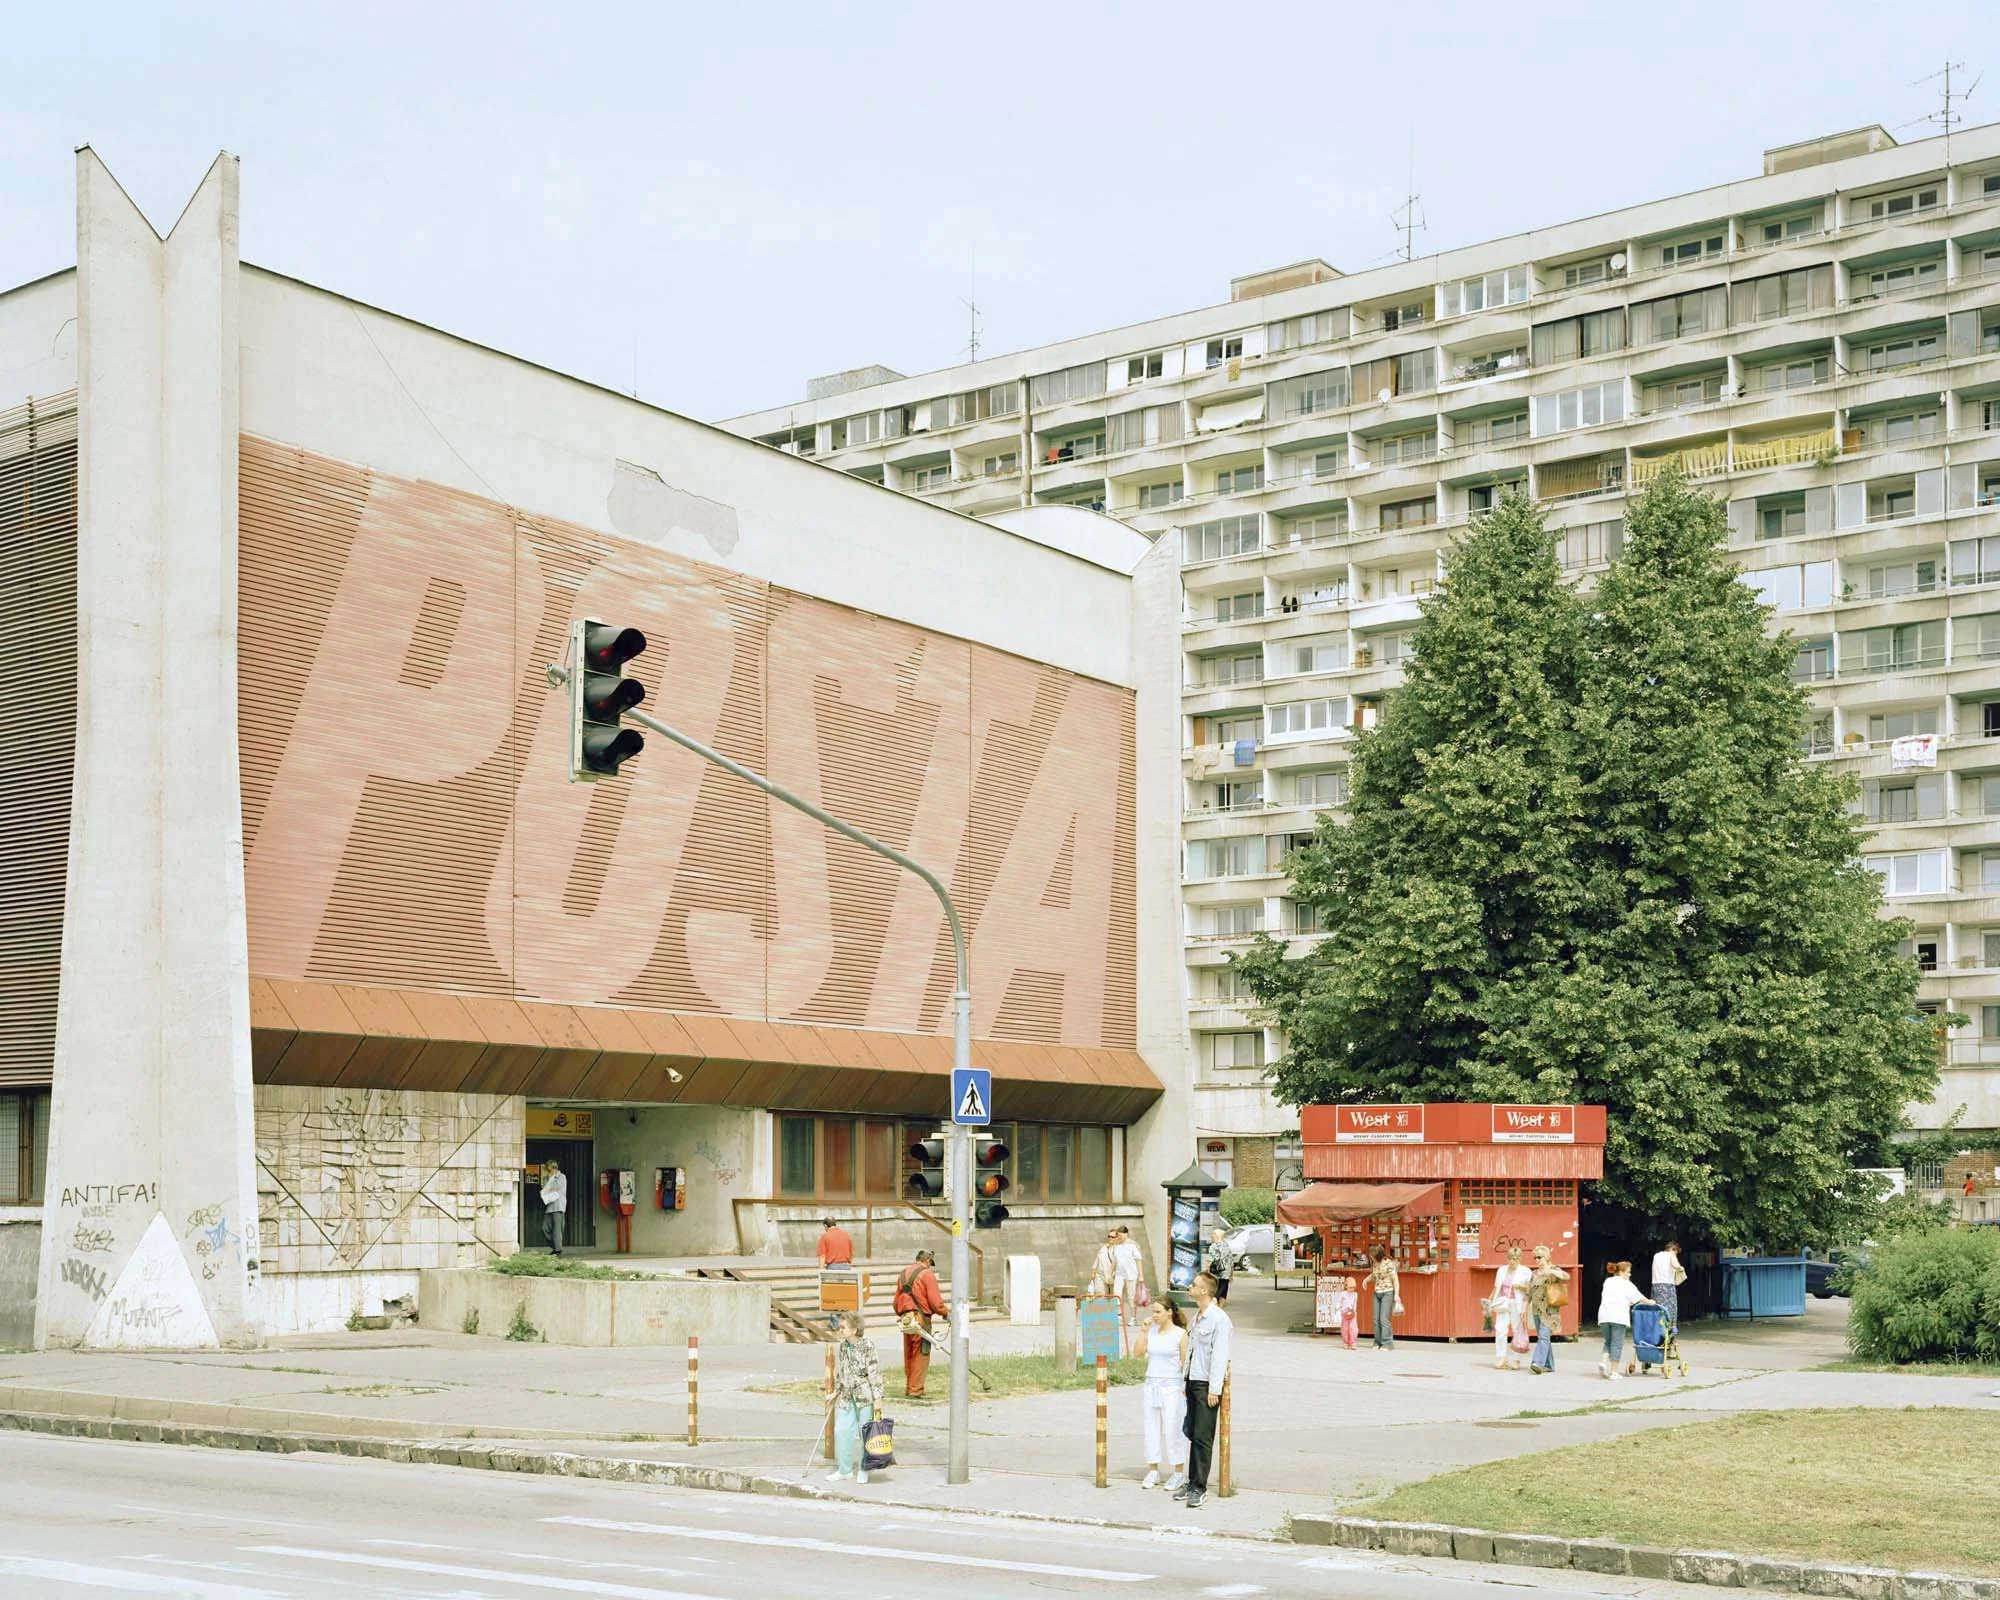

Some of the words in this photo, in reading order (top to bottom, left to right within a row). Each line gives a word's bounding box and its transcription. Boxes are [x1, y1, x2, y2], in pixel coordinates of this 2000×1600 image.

[1350, 1111, 1390, 1129] West
[1506, 1111, 1545, 1129] West
[61, 1181, 156, 1208] ANTIFA!
